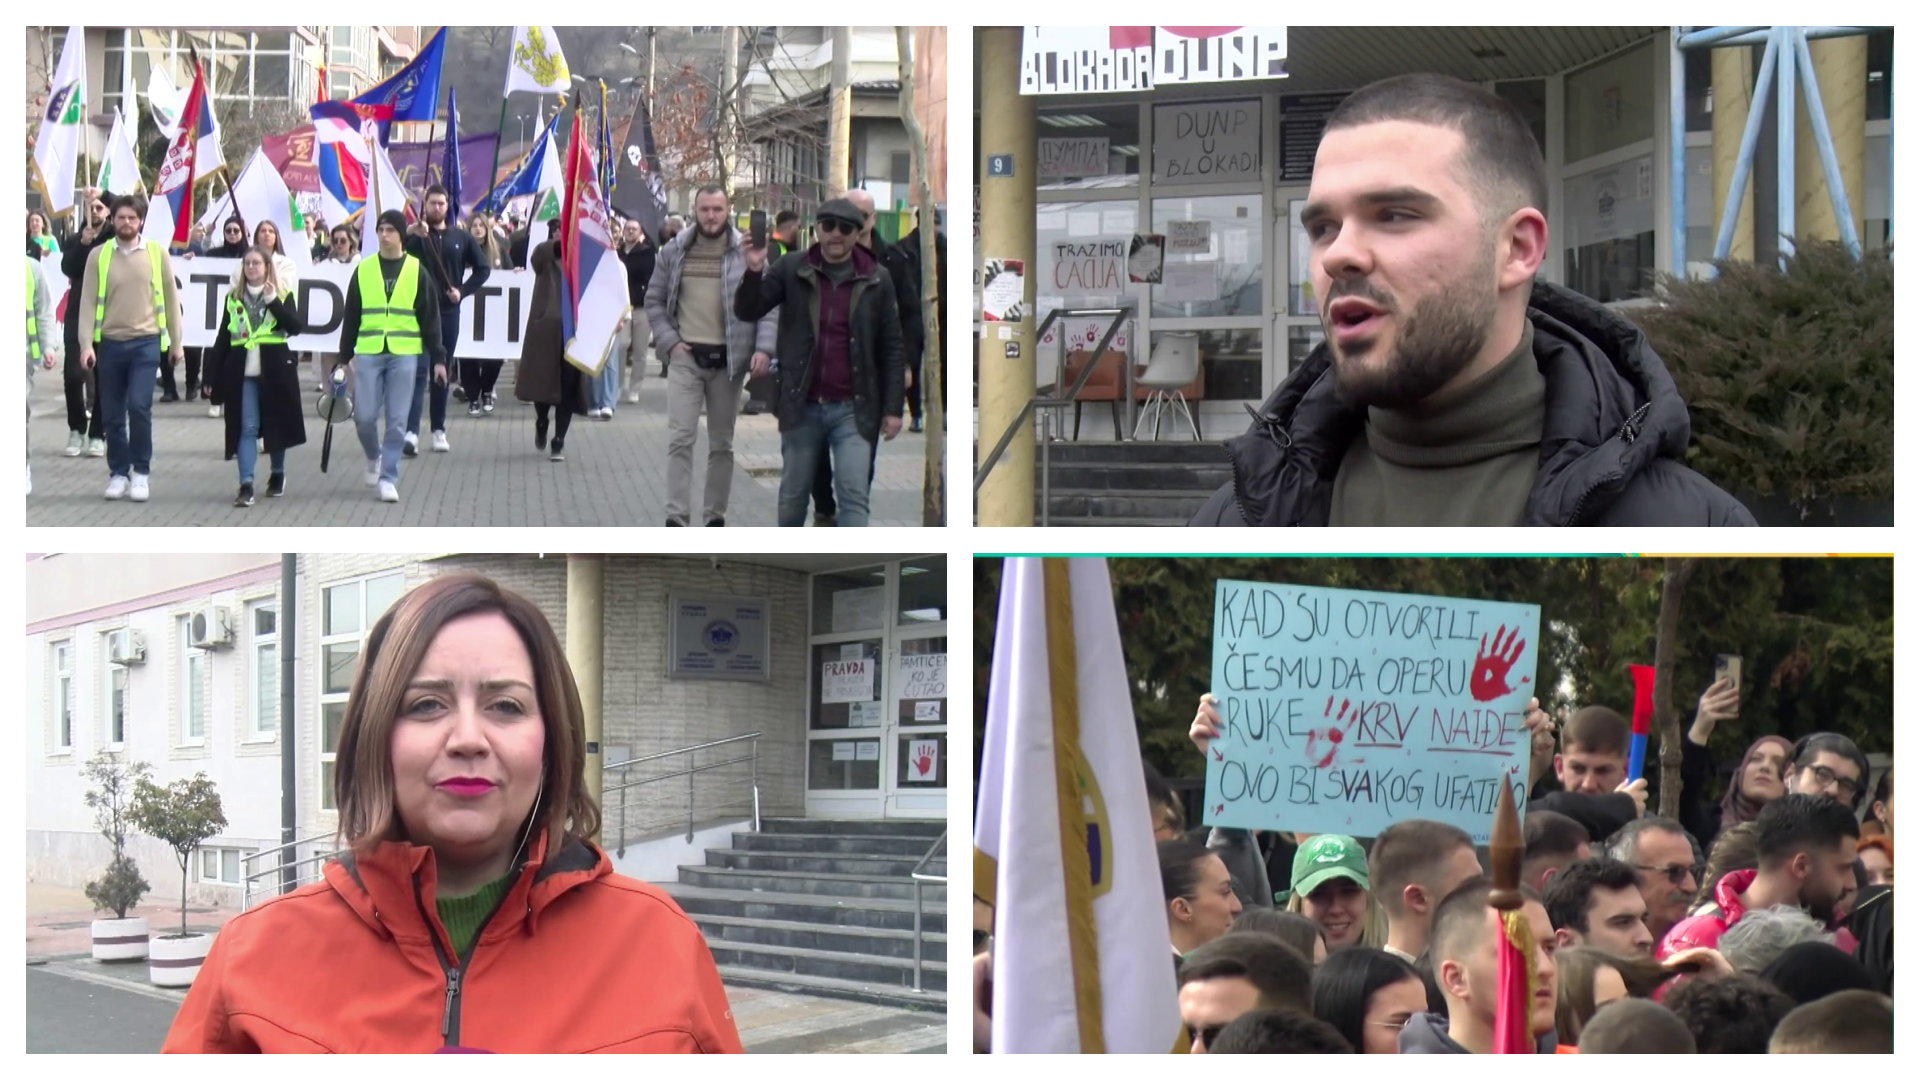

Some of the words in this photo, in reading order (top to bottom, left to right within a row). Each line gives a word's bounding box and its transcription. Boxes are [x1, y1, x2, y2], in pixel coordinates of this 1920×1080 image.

[1020, 48, 1151, 92] BLOKADA
[1155, 37, 1287, 82] DUNP
[1177, 109, 1248, 141] DUNP
[1202, 138, 1215, 155] U
[994, 157, 1003, 173] 9
[1166, 151, 1257, 178] BLOKADI
[1056, 242, 1124, 257] TRAZIMO
[1222, 587, 1285, 640] KAD
[1293, 592, 1330, 642] SU
[1345, 599, 1480, 650] OTVORILI
[825, 661, 865, 677] PRAVDA
[911, 670, 924, 683] KO
[927, 668, 940, 682] JE
[1223, 643, 1322, 692] ČESMU
[1331, 656, 1366, 692] DA
[1377, 656, 1466, 698] OPERU
[1228, 697, 1312, 748] RUKE
[1357, 700, 1419, 744] KRV
[1220, 760, 1279, 804] OVO
[1289, 765, 1319, 805] BI
